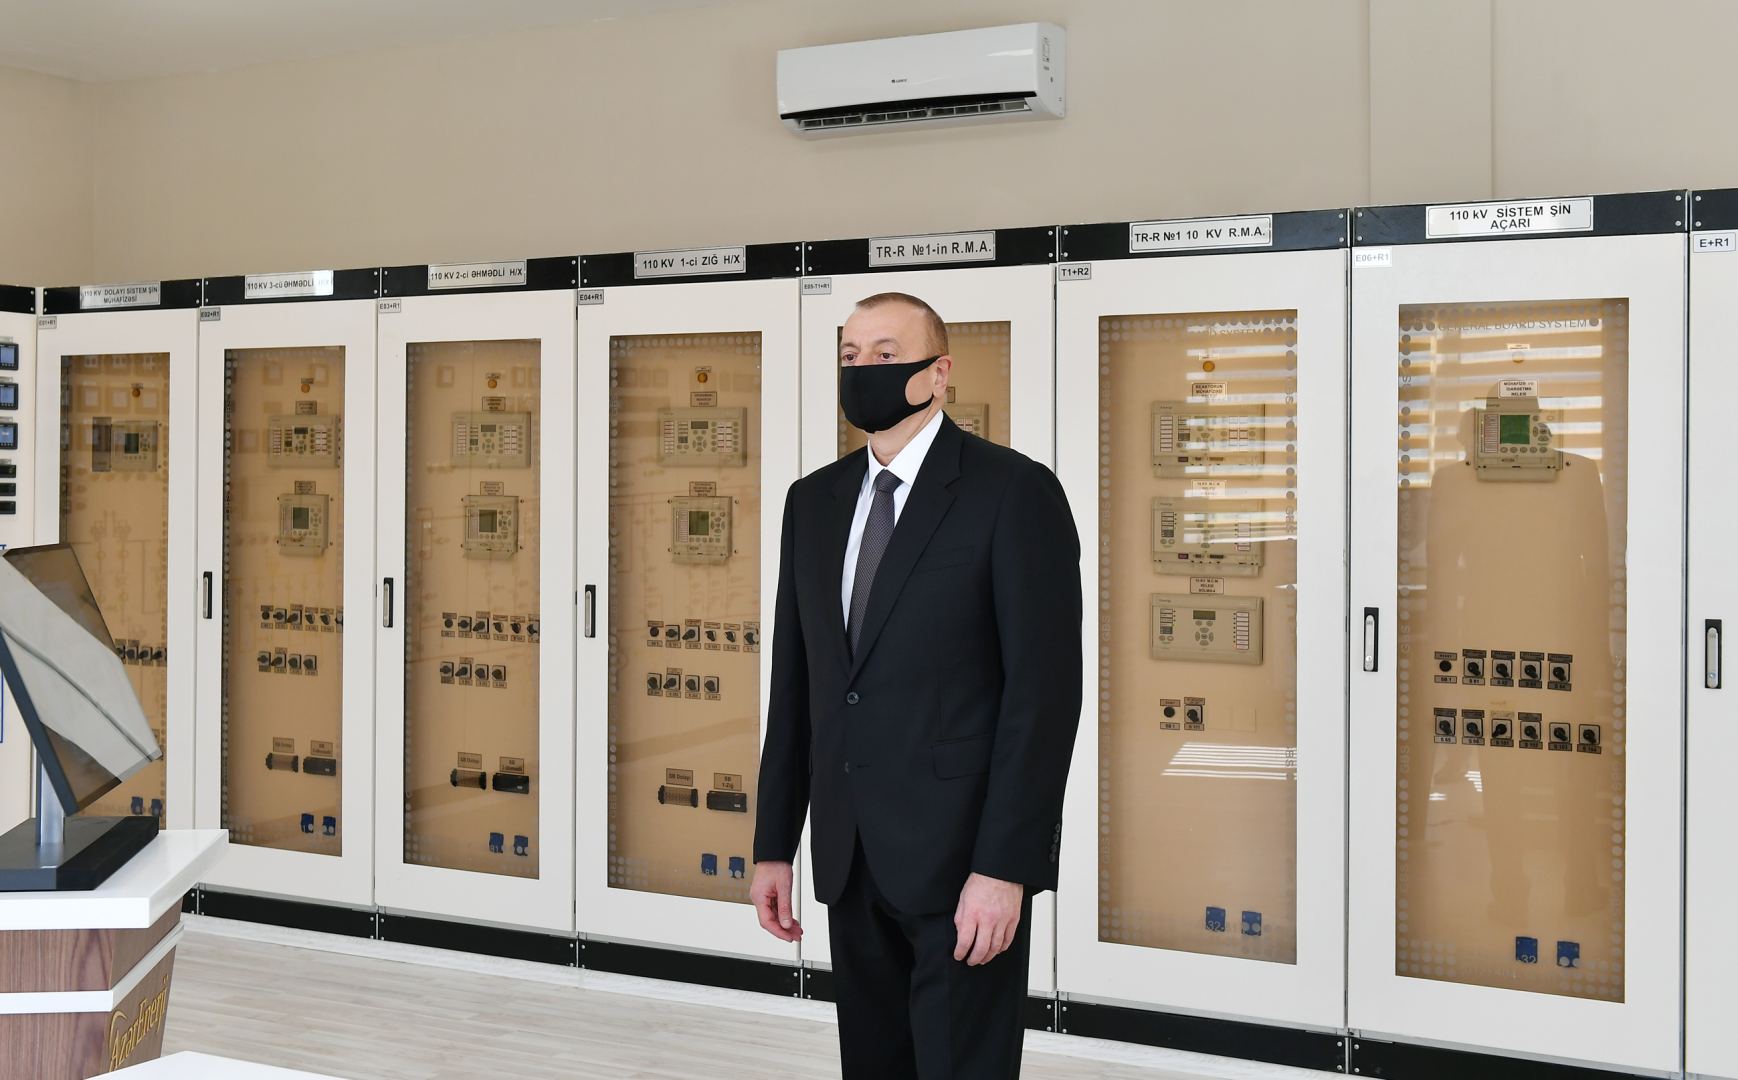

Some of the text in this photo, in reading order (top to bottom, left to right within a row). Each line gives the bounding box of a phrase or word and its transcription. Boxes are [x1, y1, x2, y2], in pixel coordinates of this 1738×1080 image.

[1449, 204, 1571, 221] 110 kV SİSTEM ŞİN
[1490, 219, 1530, 231] AÇARI
[1134, 232, 1160, 243] TR-R
[1187, 230, 1199, 240] 10
[1206, 229, 1222, 239] KV
[1229, 226, 1266, 238] R.M.A.
[1700, 238, 1729, 247] E+R1
[876, 245, 905, 258] TR-R
[952, 241, 992, 254] R.M.A.
[643, 254, 740, 269] 110 KV 1-ci ZIĞ H/X
[1355, 253, 1389, 262] E06+R1
[444, 272, 454, 280] KV
[456, 271, 469, 279] 2-ci
[471, 267, 505, 278] ƏHMƏDLİ
[510, 268, 522, 276] H/X
[1061, 267, 1089, 277] T1+R2
[1538, 318, 1588, 330] SYSTEM
